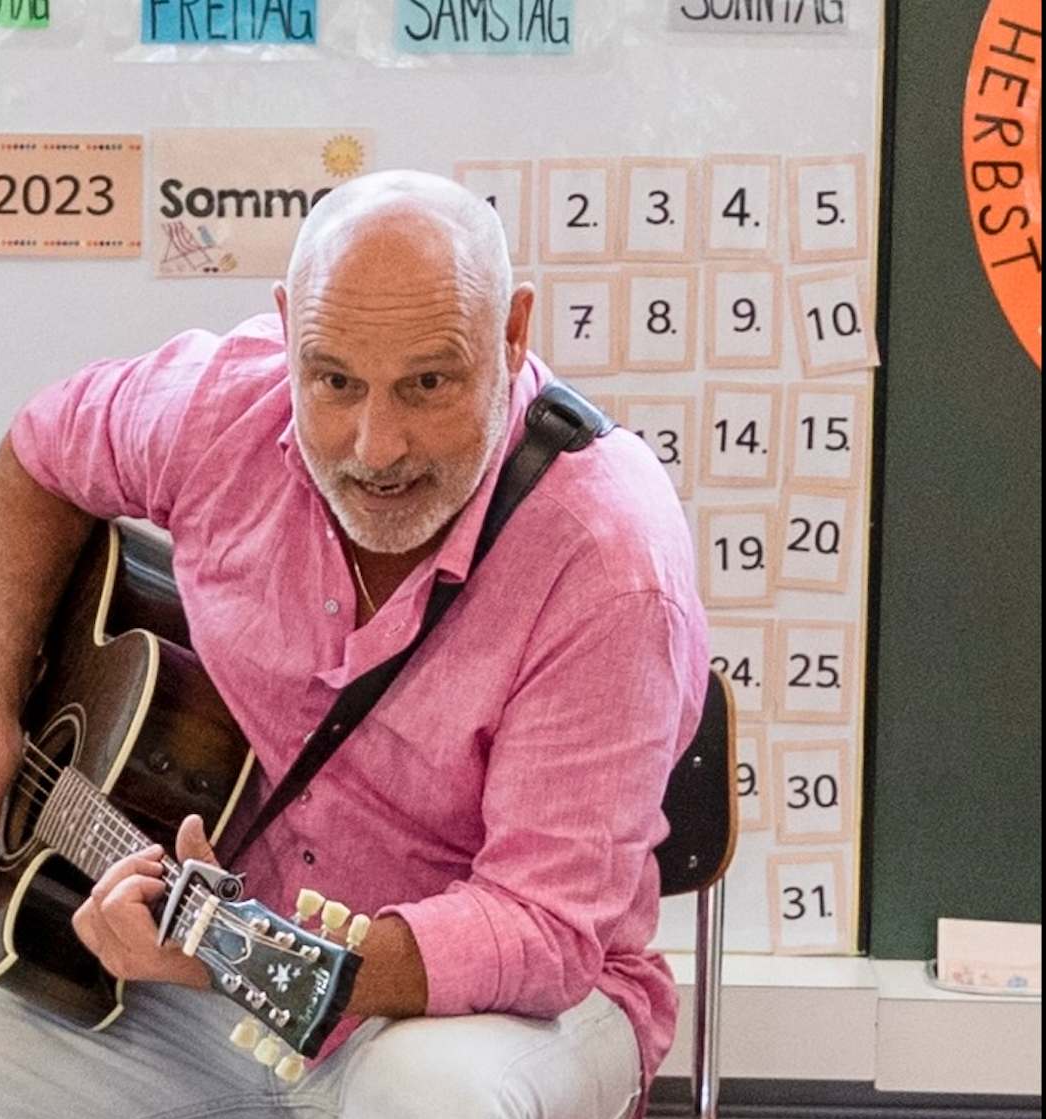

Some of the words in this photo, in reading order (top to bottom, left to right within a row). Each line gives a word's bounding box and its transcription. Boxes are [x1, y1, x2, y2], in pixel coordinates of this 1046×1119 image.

[971, 17, 1042, 274] HERBST
[160, 178, 334, 219] Somm
[567, 193, 597, 228] 2.
[646, 190, 675, 225] 3.
[722, 188, 760, 227] 4.
[816, 190, 845, 226] 5.
[570, 305, 594, 340] 7.
[647, 299, 677, 335] 8.
[732, 297, 761, 333] 9.
[807, 301, 861, 341] 10.
[635, 429, 681, 465] 3.
[714, 419, 768, 454] 14.
[802, 416, 851, 452] 15.
[714, 536, 765, 571] 19.
[788, 653, 841, 689] 25.
[736, 762, 759, 797] 9.
[783, 886, 833, 921] 31.
